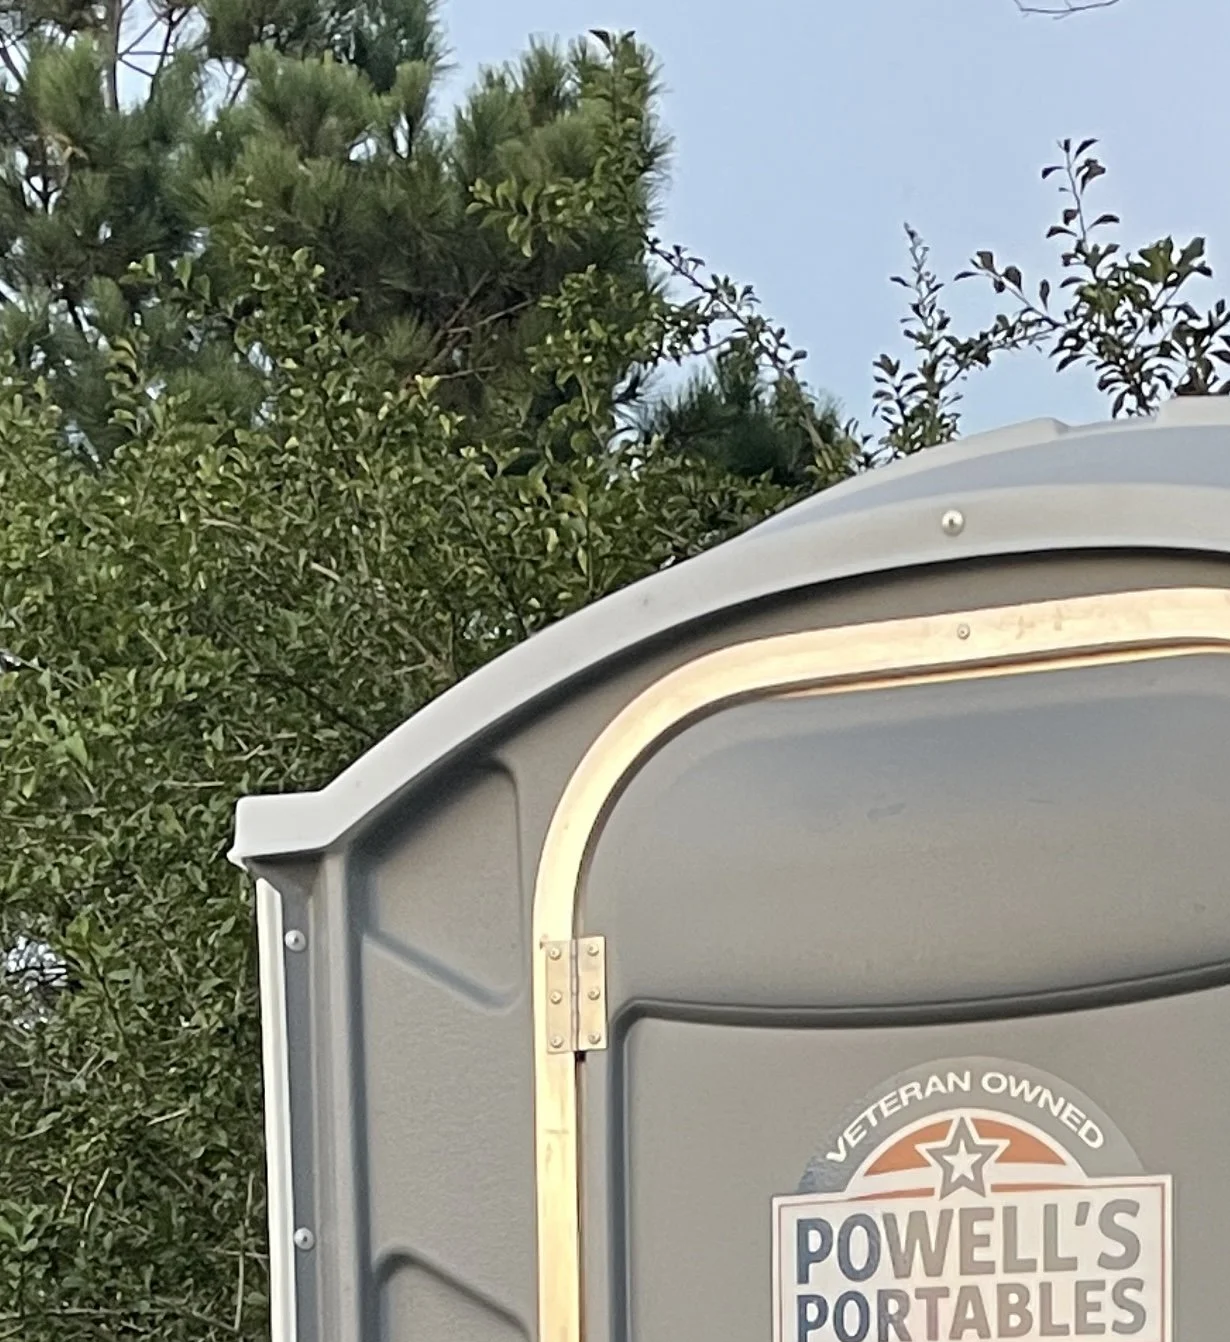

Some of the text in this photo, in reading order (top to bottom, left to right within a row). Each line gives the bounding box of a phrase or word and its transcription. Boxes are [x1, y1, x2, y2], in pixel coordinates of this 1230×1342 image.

[826, 1071, 1105, 1165] VETERAN OWNED
[796, 1198, 1142, 1285] POWELL'S
